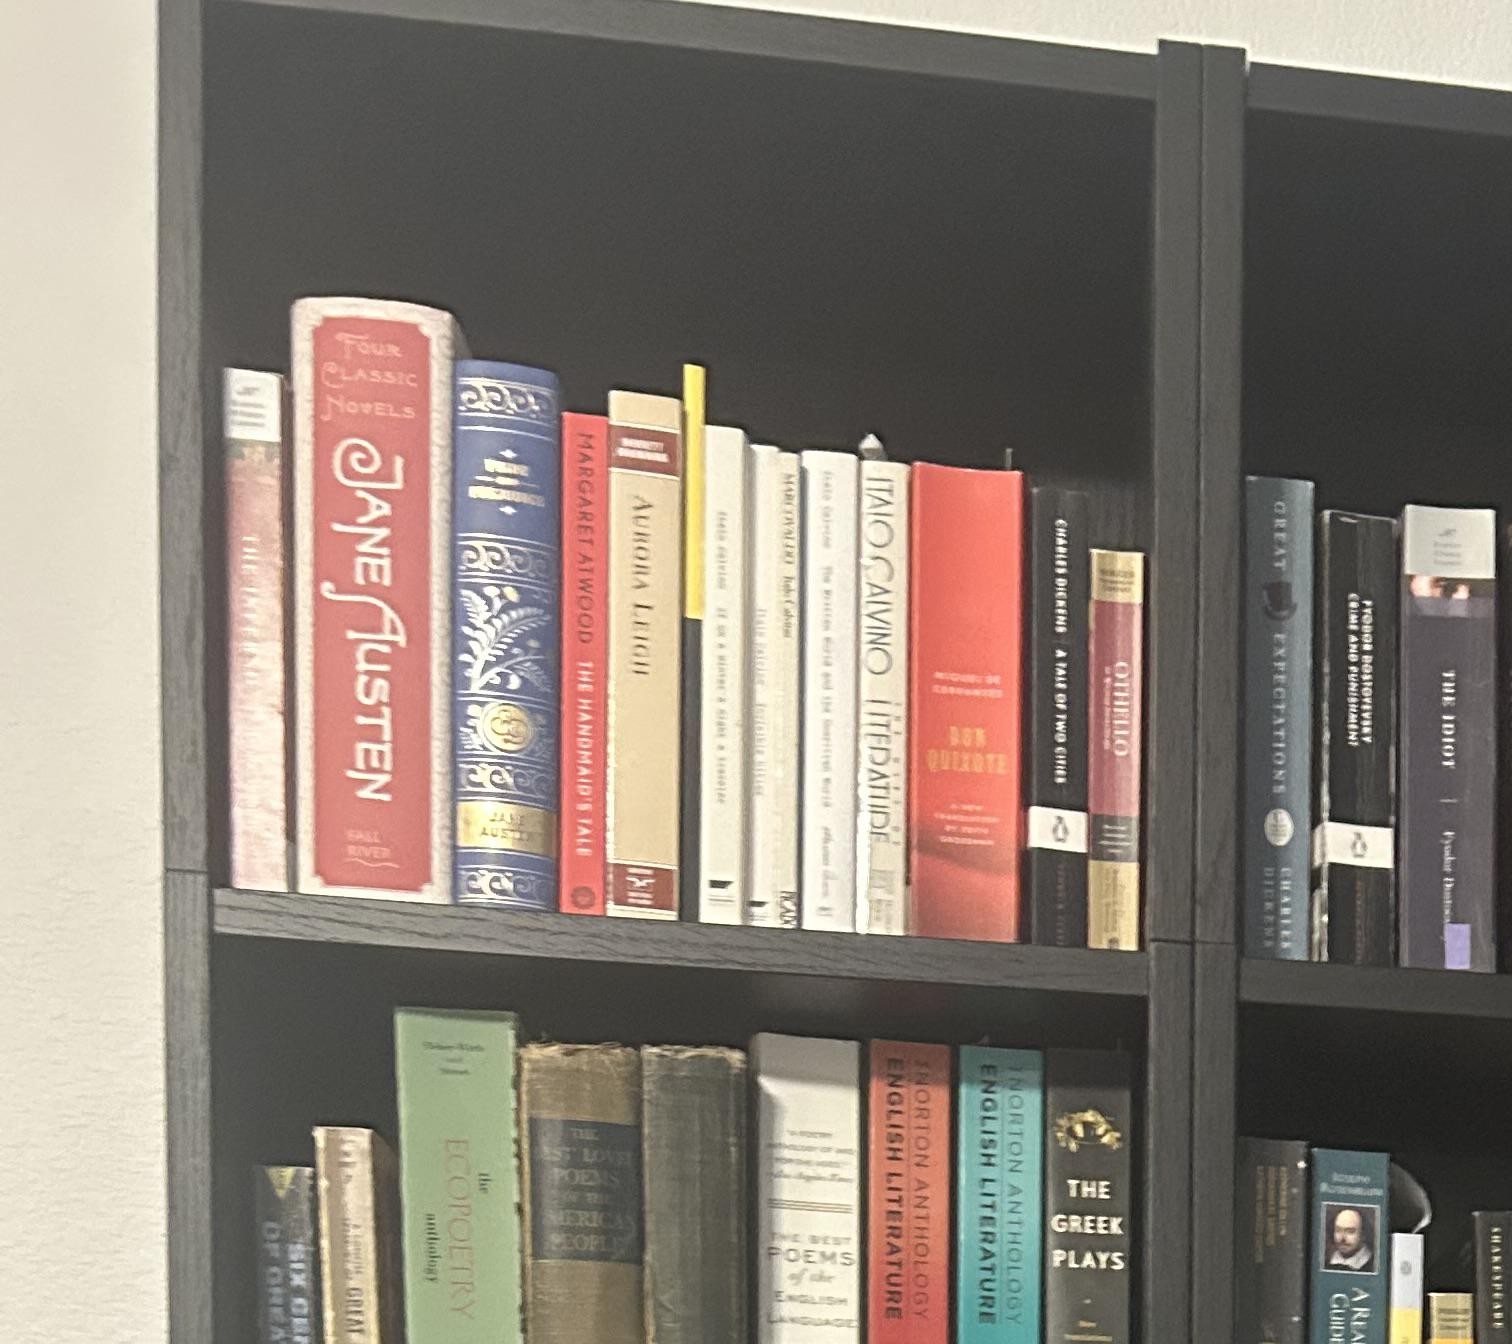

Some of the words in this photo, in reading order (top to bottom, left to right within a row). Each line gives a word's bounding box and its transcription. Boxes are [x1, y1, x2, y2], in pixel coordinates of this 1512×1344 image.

[332, 438, 405, 585] JANE
[575, 432, 595, 545] MARGARET
[1055, 520, 1067, 574] CHARLES
[576, 553, 596, 644] ATWOOD
[1055, 578, 1067, 633] DICKENS
[320, 582, 407, 801] AUSTEN
[576, 661, 593, 692] THE
[576, 699, 593, 812] HANDMAID'S
[575, 818, 593, 857] TALE
[980, 1064, 996, 1168] ENGLISH
[1052, 1215, 1123, 1235] GREEK
[1067, 1180, 1111, 1199] THE
[445, 1138, 474, 1320] ECOPOETRY
[978, 1178, 995, 1324] LITERATURE
[1053, 1250, 1124, 1270] PLAYS
[1352, 1288, 1369, 1301] A
